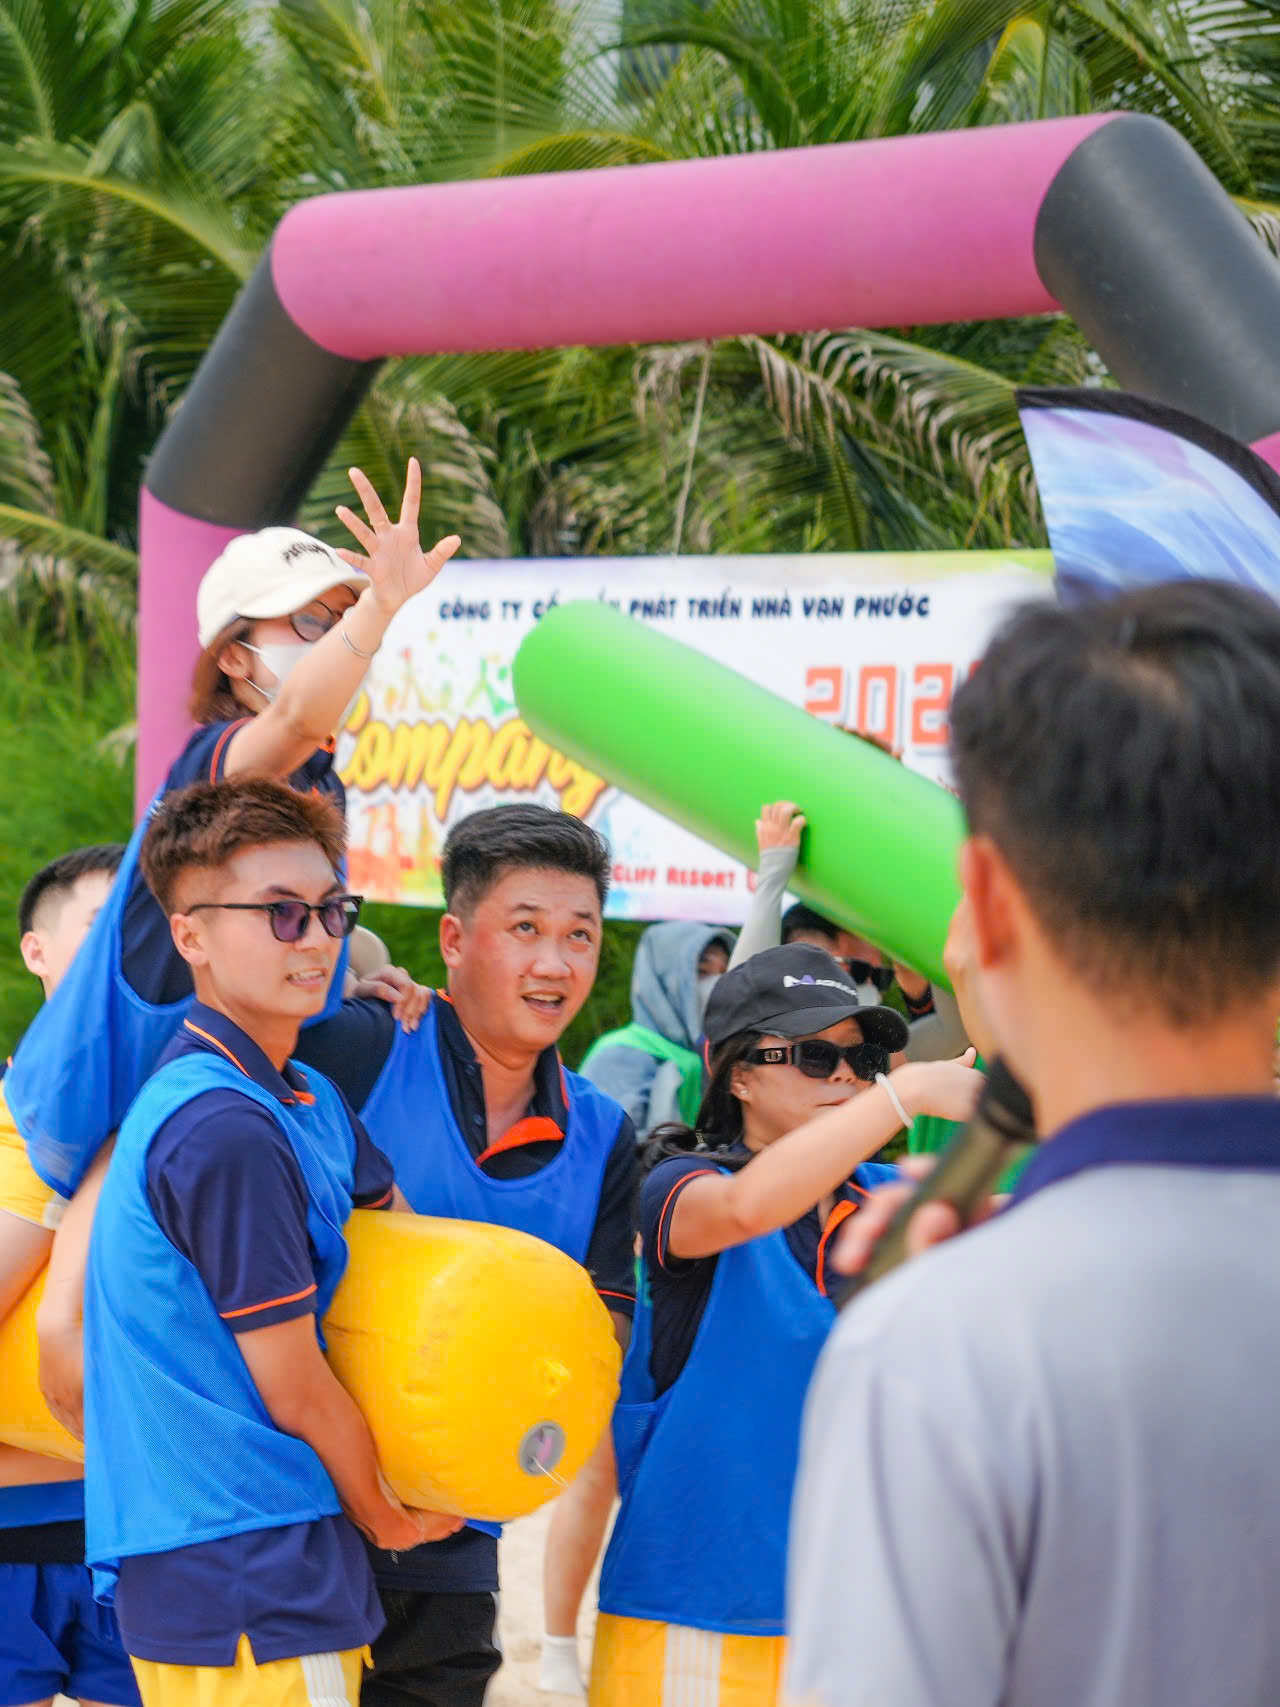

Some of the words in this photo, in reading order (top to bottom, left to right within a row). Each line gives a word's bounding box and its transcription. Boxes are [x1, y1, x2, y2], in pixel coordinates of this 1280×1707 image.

[502, 600, 522, 620] TY
[805, 664, 984, 745] 202
[666, 866, 736, 887] RESORT
